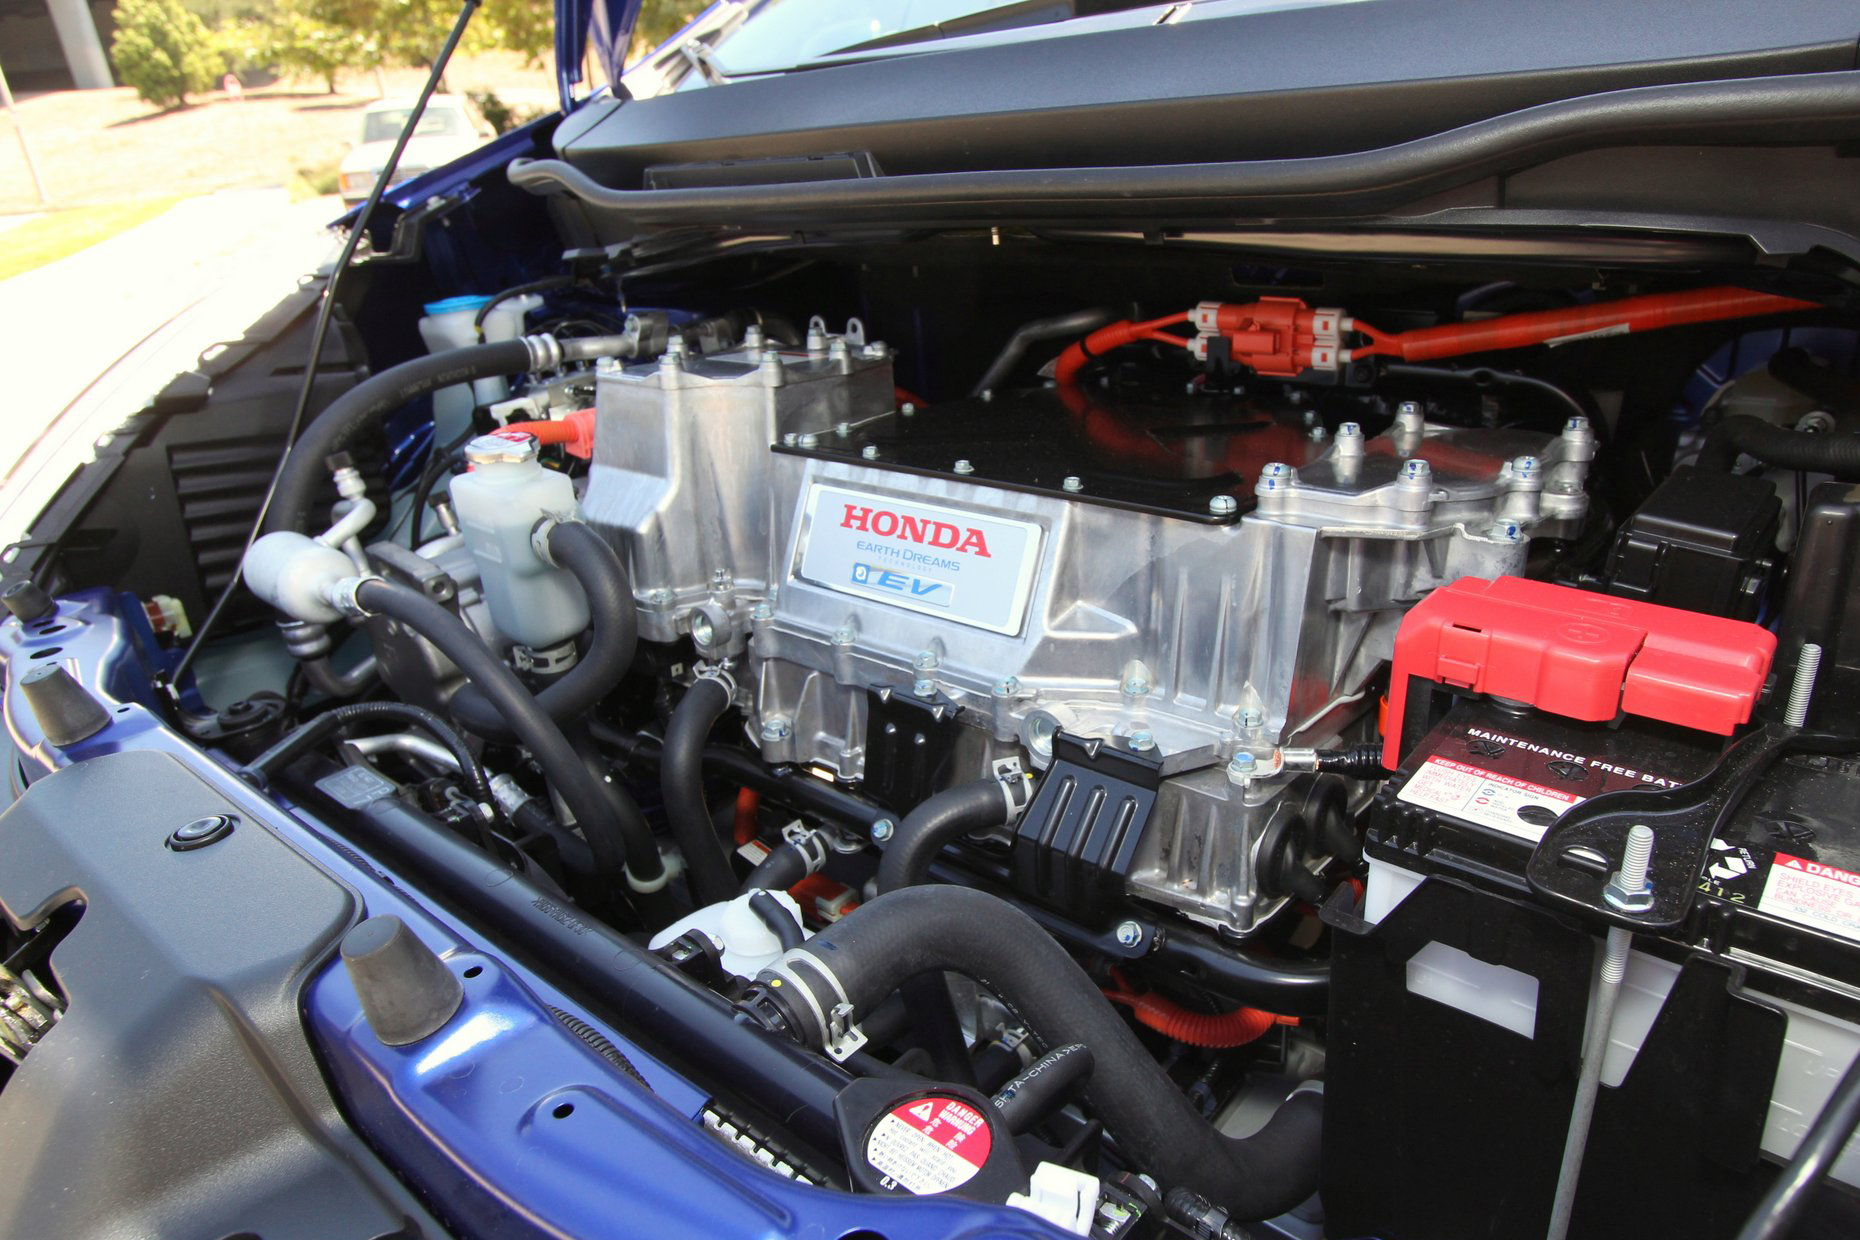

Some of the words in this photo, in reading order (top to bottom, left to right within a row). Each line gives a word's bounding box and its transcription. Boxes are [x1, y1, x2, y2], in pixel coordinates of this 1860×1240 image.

[840, 503, 992, 559] HONDA
[856, 540, 900, 560] EARTH
[902, 549, 961, 572] DREAMS
[877, 571, 943, 596] EV
[1467, 728, 1586, 765] MAINTENANCE
[1590, 759, 1637, 779] FREE
[1641, 773, 1688, 789] BAT
[1434, 758, 1457, 768] KEEP
[1456, 765, 1475, 773] OUT
[1473, 769, 1486, 777] OF
[1485, 772, 1514, 786] REACH
[1527, 785, 1570, 801] CHILDREN
[1775, 887, 1797, 897] CAN
[1777, 879, 1841, 903] EXPLOSIVE
[1780, 872, 1821, 888] SHIELD
[1823, 884, 1854, 898] EYES
[938, 1109, 977, 1136] WARNUNG
[946, 1101, 985, 1128] DANGER
